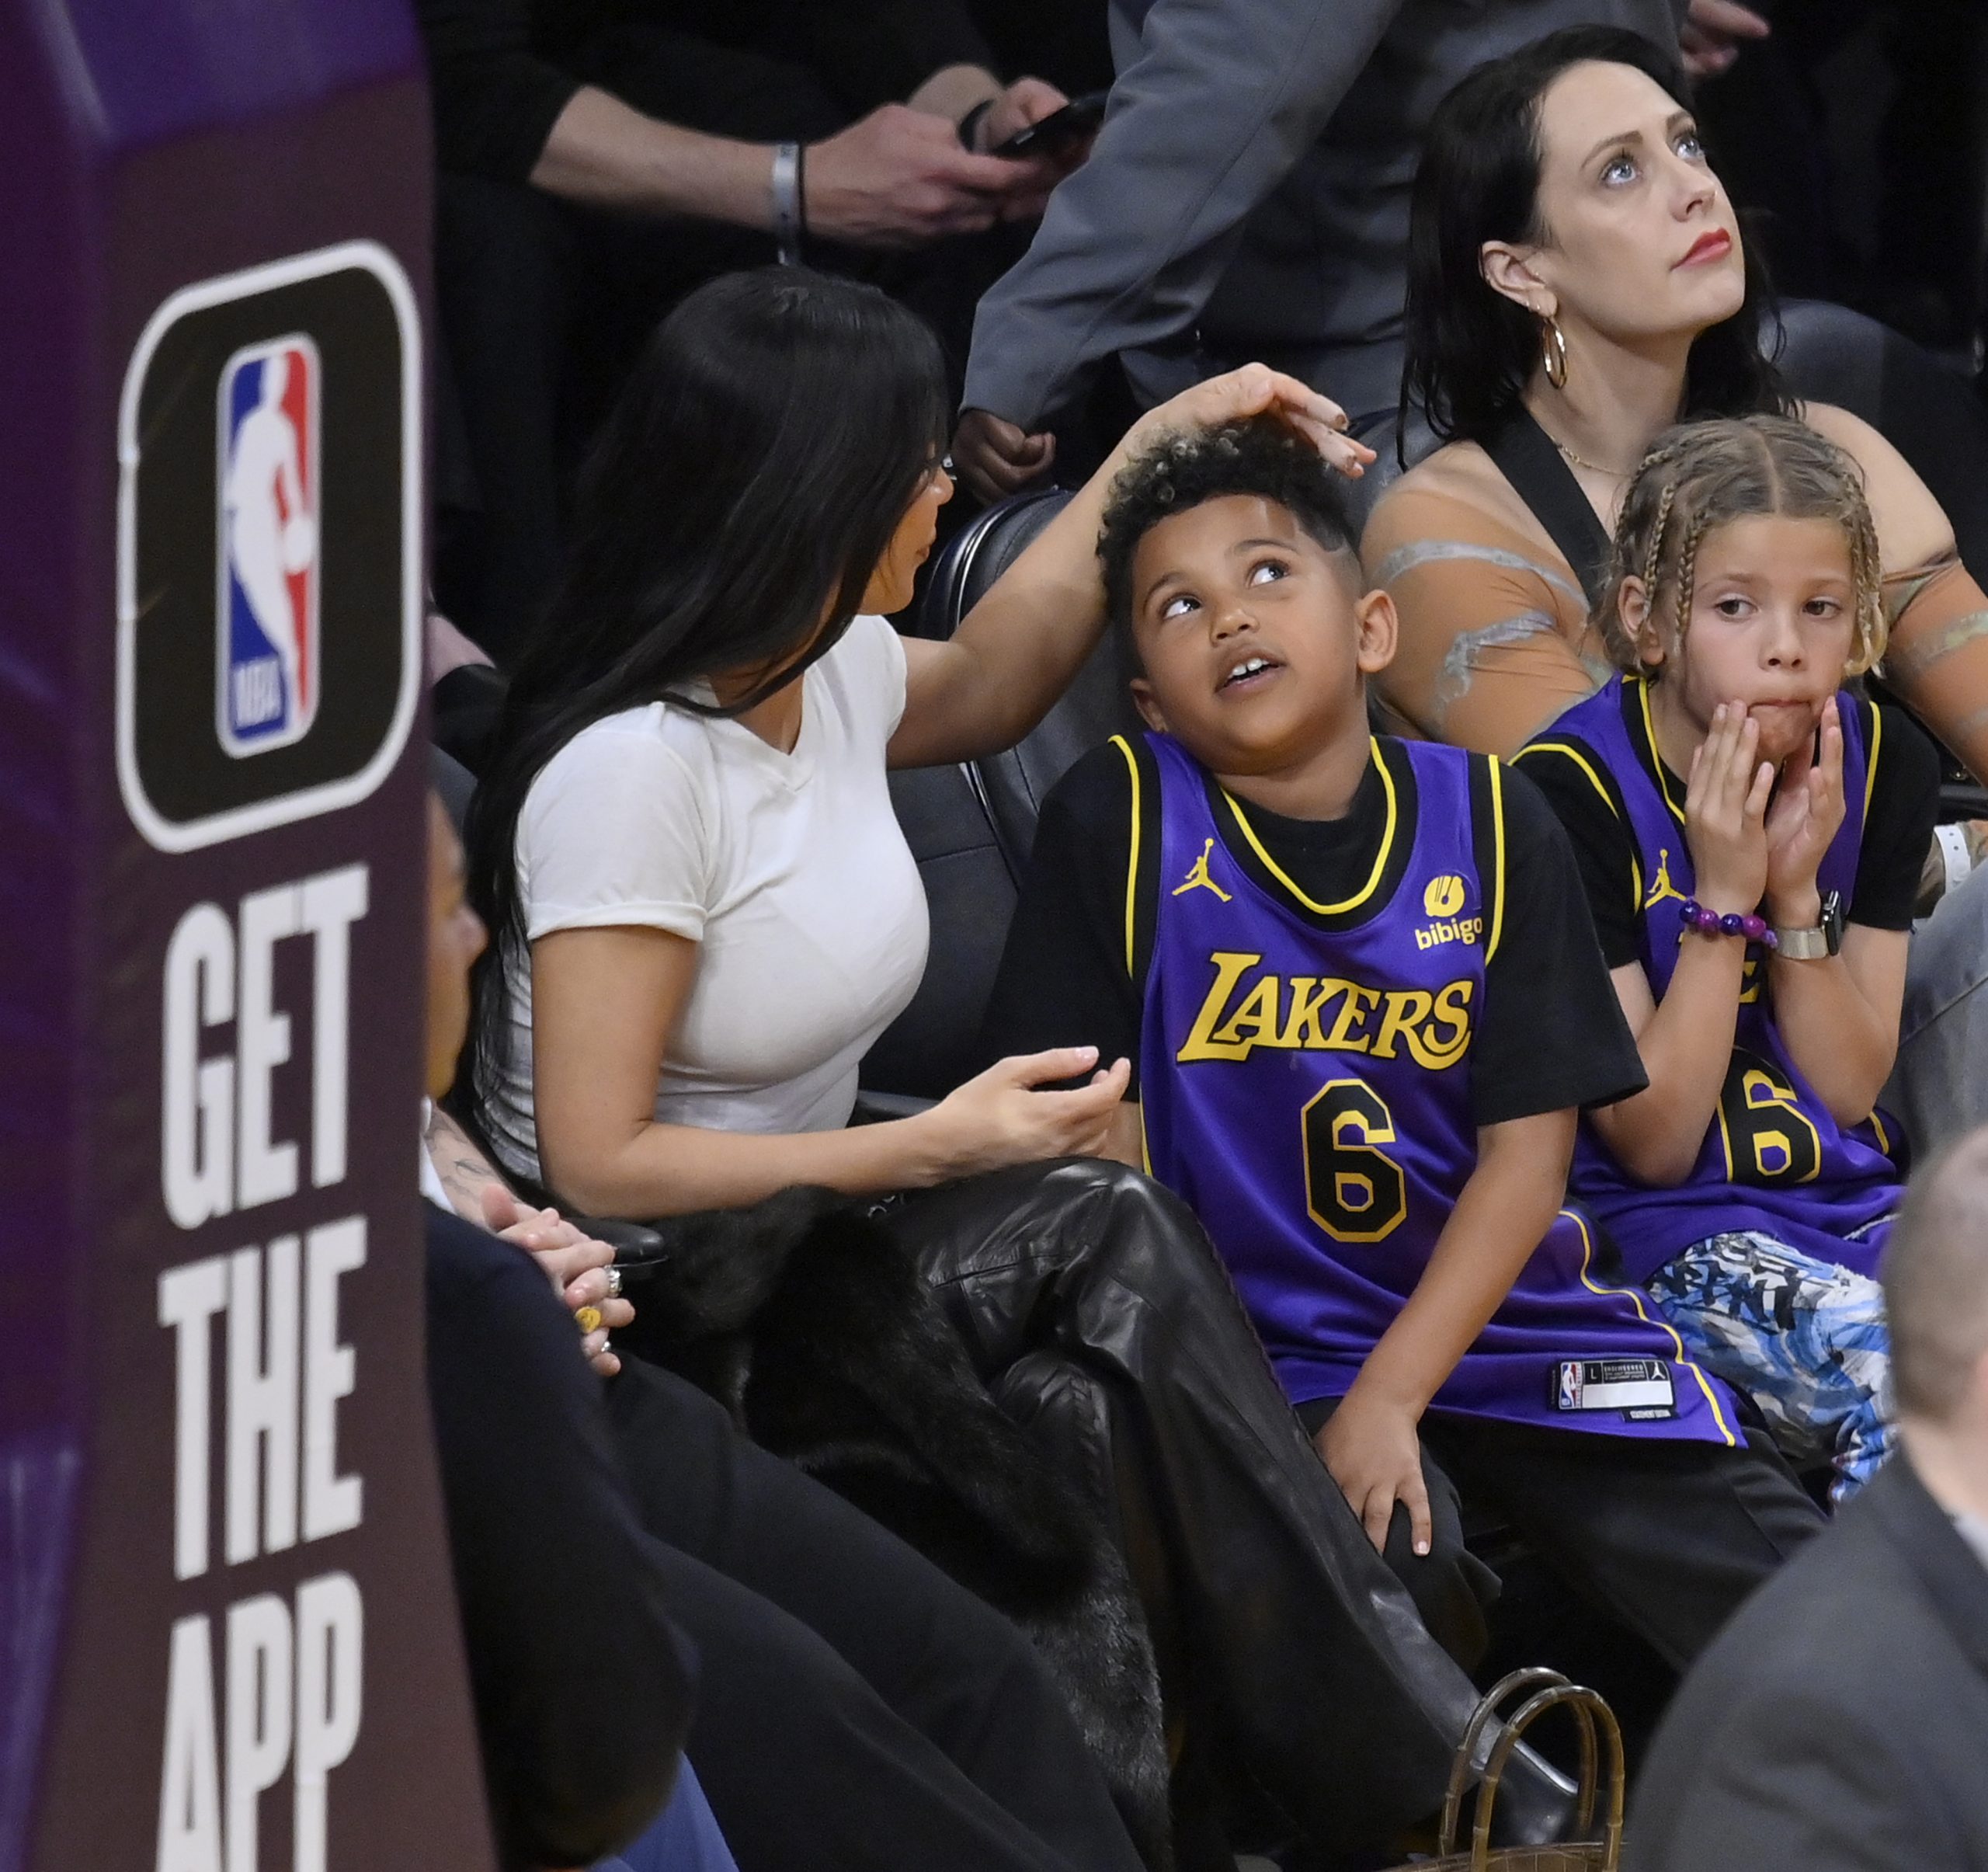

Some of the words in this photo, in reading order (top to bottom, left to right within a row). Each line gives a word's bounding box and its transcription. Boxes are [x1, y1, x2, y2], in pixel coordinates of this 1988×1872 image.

[1415, 917, 1483, 950] bibigo
[162, 861, 370, 1231] GET
[1176, 951, 1474, 1071] LAKERS
[1300, 1078, 1407, 1243] 6
[1716, 1046, 1821, 1183] 6
[157, 1213, 369, 1582] THE
[1590, 1368, 1597, 1380] L
[156, 1571, 365, 1872] APP
